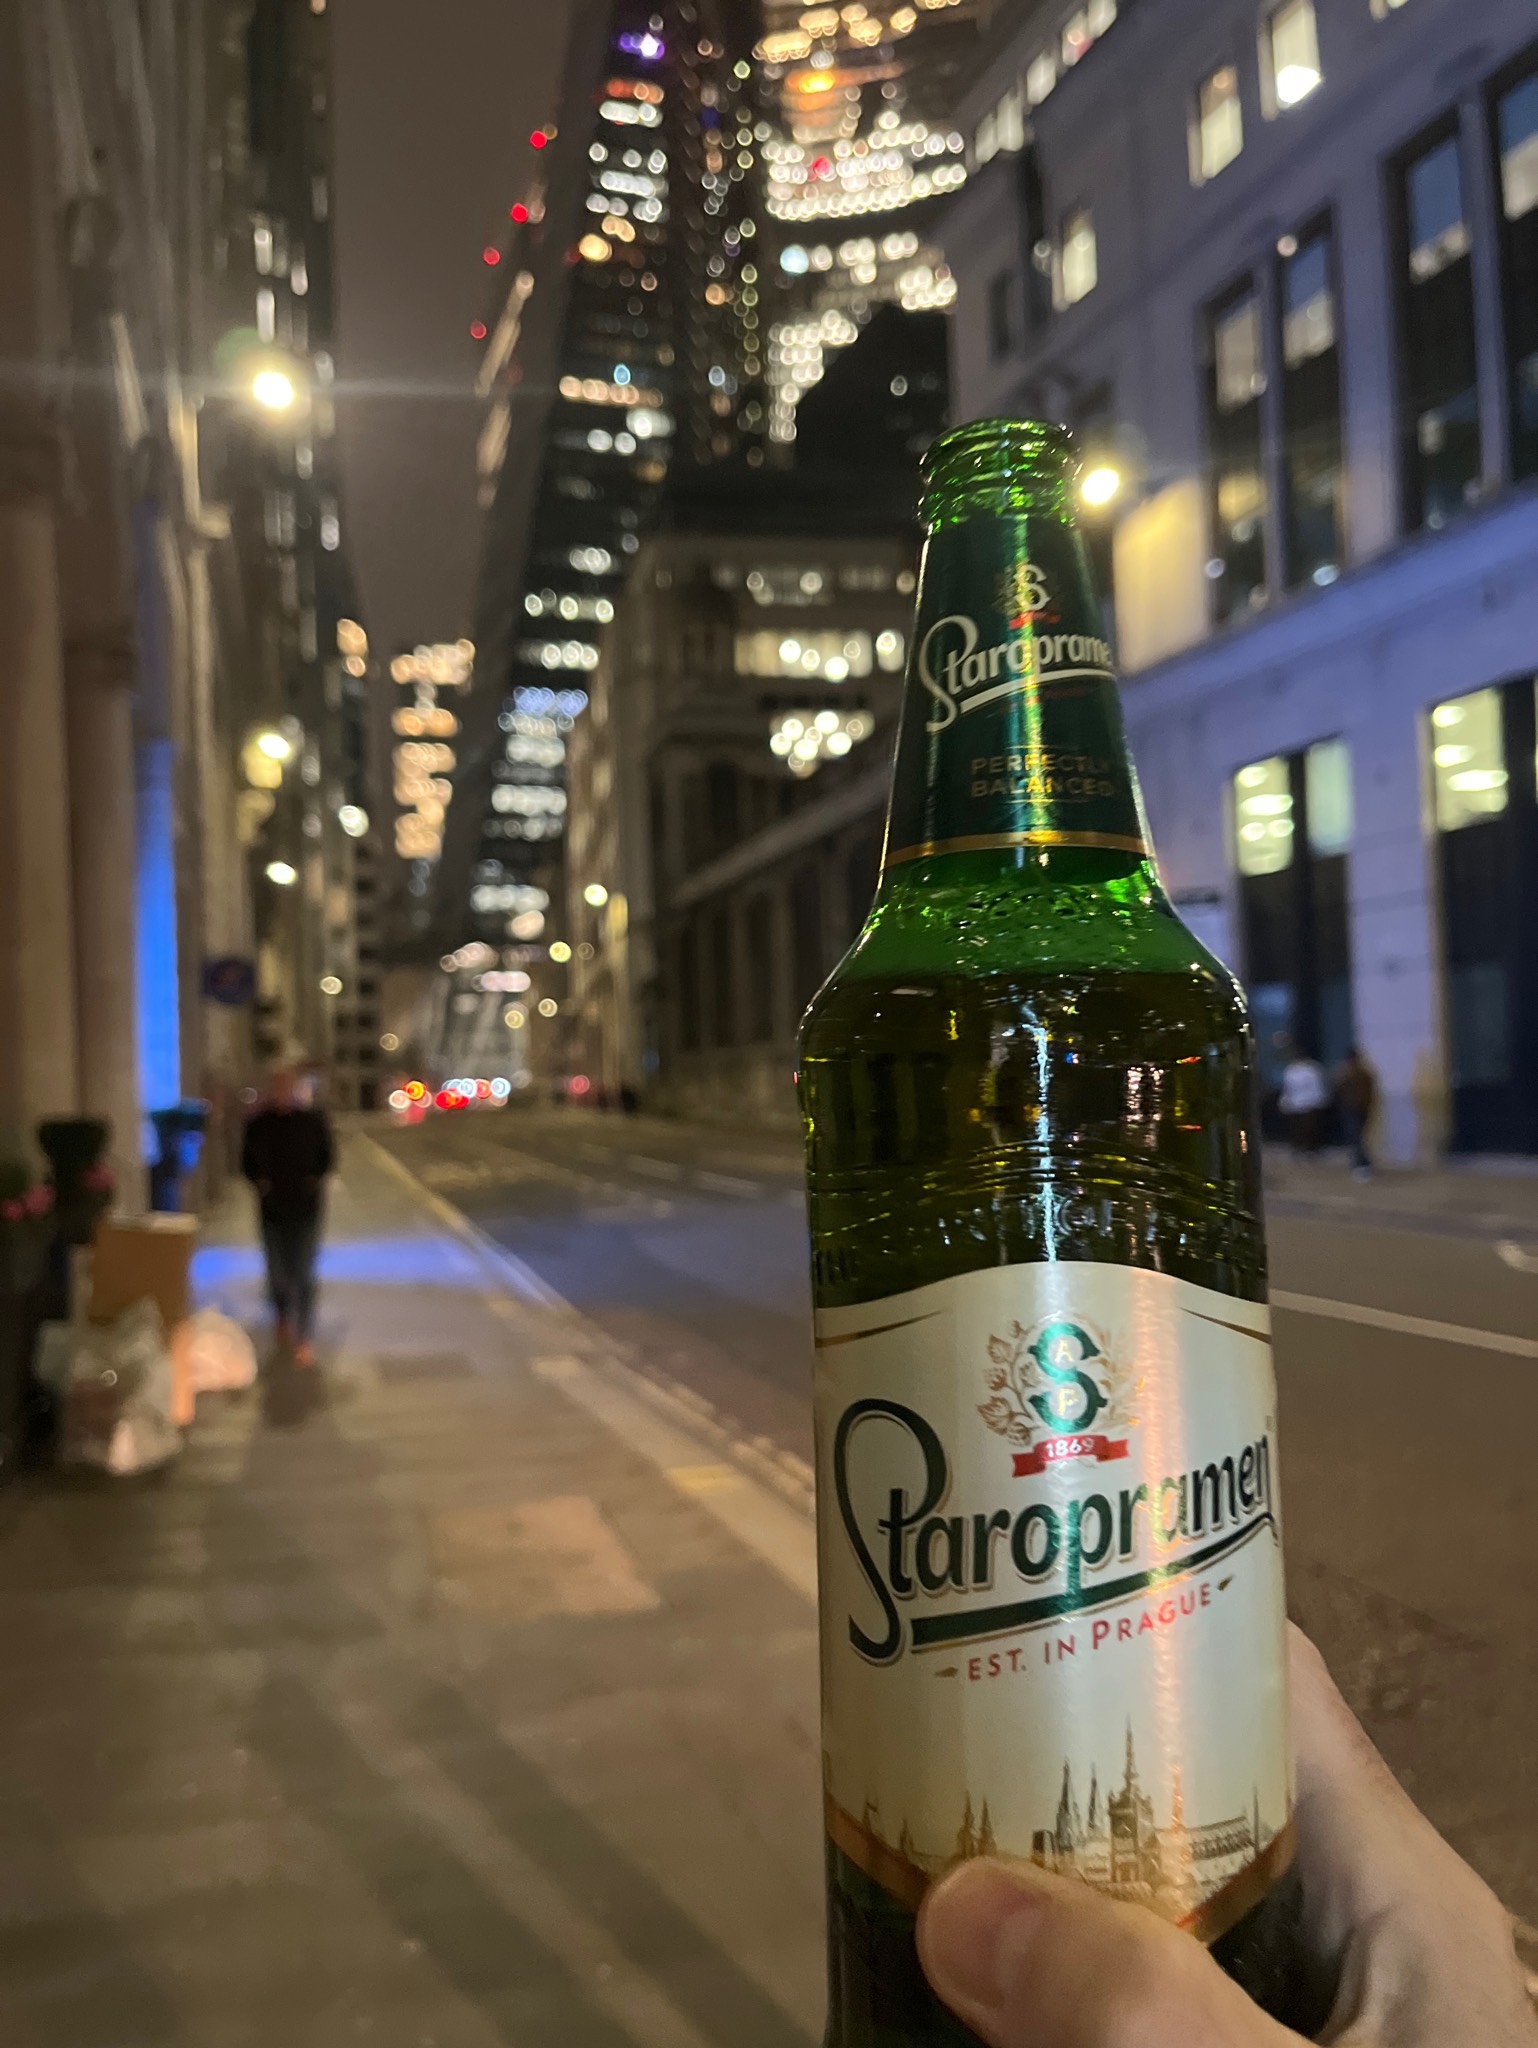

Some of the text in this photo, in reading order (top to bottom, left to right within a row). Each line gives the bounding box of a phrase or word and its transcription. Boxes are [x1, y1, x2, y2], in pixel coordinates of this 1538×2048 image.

[919, 614, 1114, 732] Staroprame
[970, 775, 1114, 798] BALANCED
[1045, 1436, 1095, 1458] 1869
[833, 1398, 1272, 1662] Staropramen
[967, 1582, 1211, 1681] EST. IN PRAGUE
